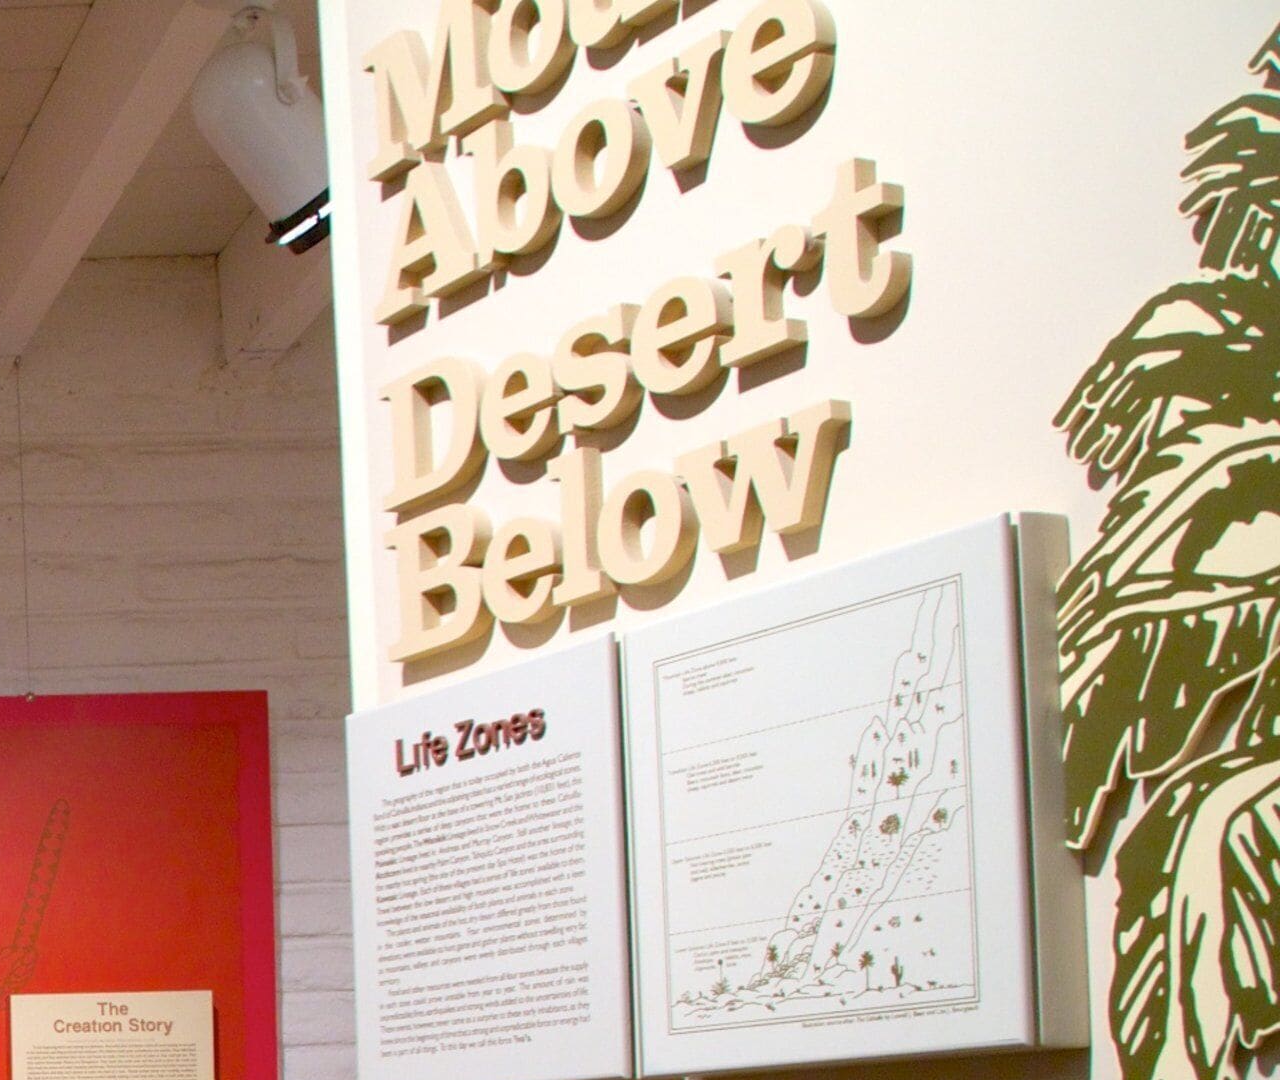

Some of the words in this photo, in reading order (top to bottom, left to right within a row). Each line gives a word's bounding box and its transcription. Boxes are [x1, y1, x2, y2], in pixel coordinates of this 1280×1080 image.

[376, 0, 837, 324] Above
[381, 158, 913, 512] Desert
[385, 400, 852, 662] Below
[395, 730, 449, 777] Life
[455, 706, 547, 762] Zones
[53, 1020, 123, 1033] Creation
[128, 1019, 174, 1036] Story
[97, 1002, 129, 1016] The
